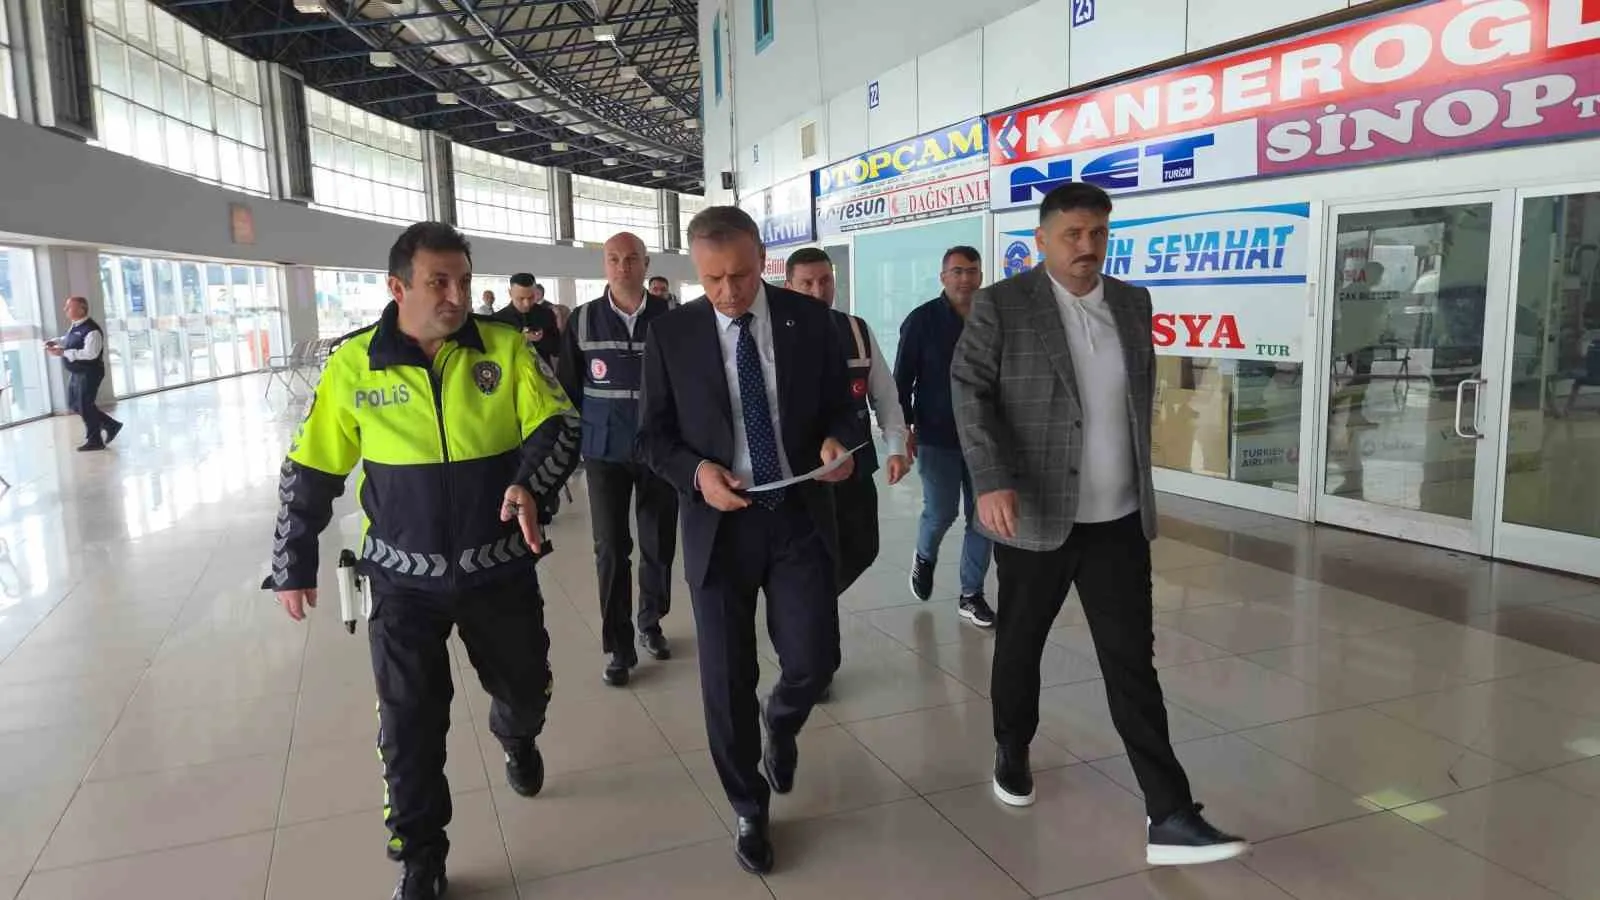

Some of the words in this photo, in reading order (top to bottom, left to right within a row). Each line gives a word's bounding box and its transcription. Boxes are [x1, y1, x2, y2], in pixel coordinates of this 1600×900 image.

[1266, 74, 1577, 162] SİNOP
[1010, 133, 1215, 202] NET
[1144, 224, 1295, 274] SEYAHAT
[1255, 344, 1291, 357] TUR
[355, 384, 410, 409] POLİS
